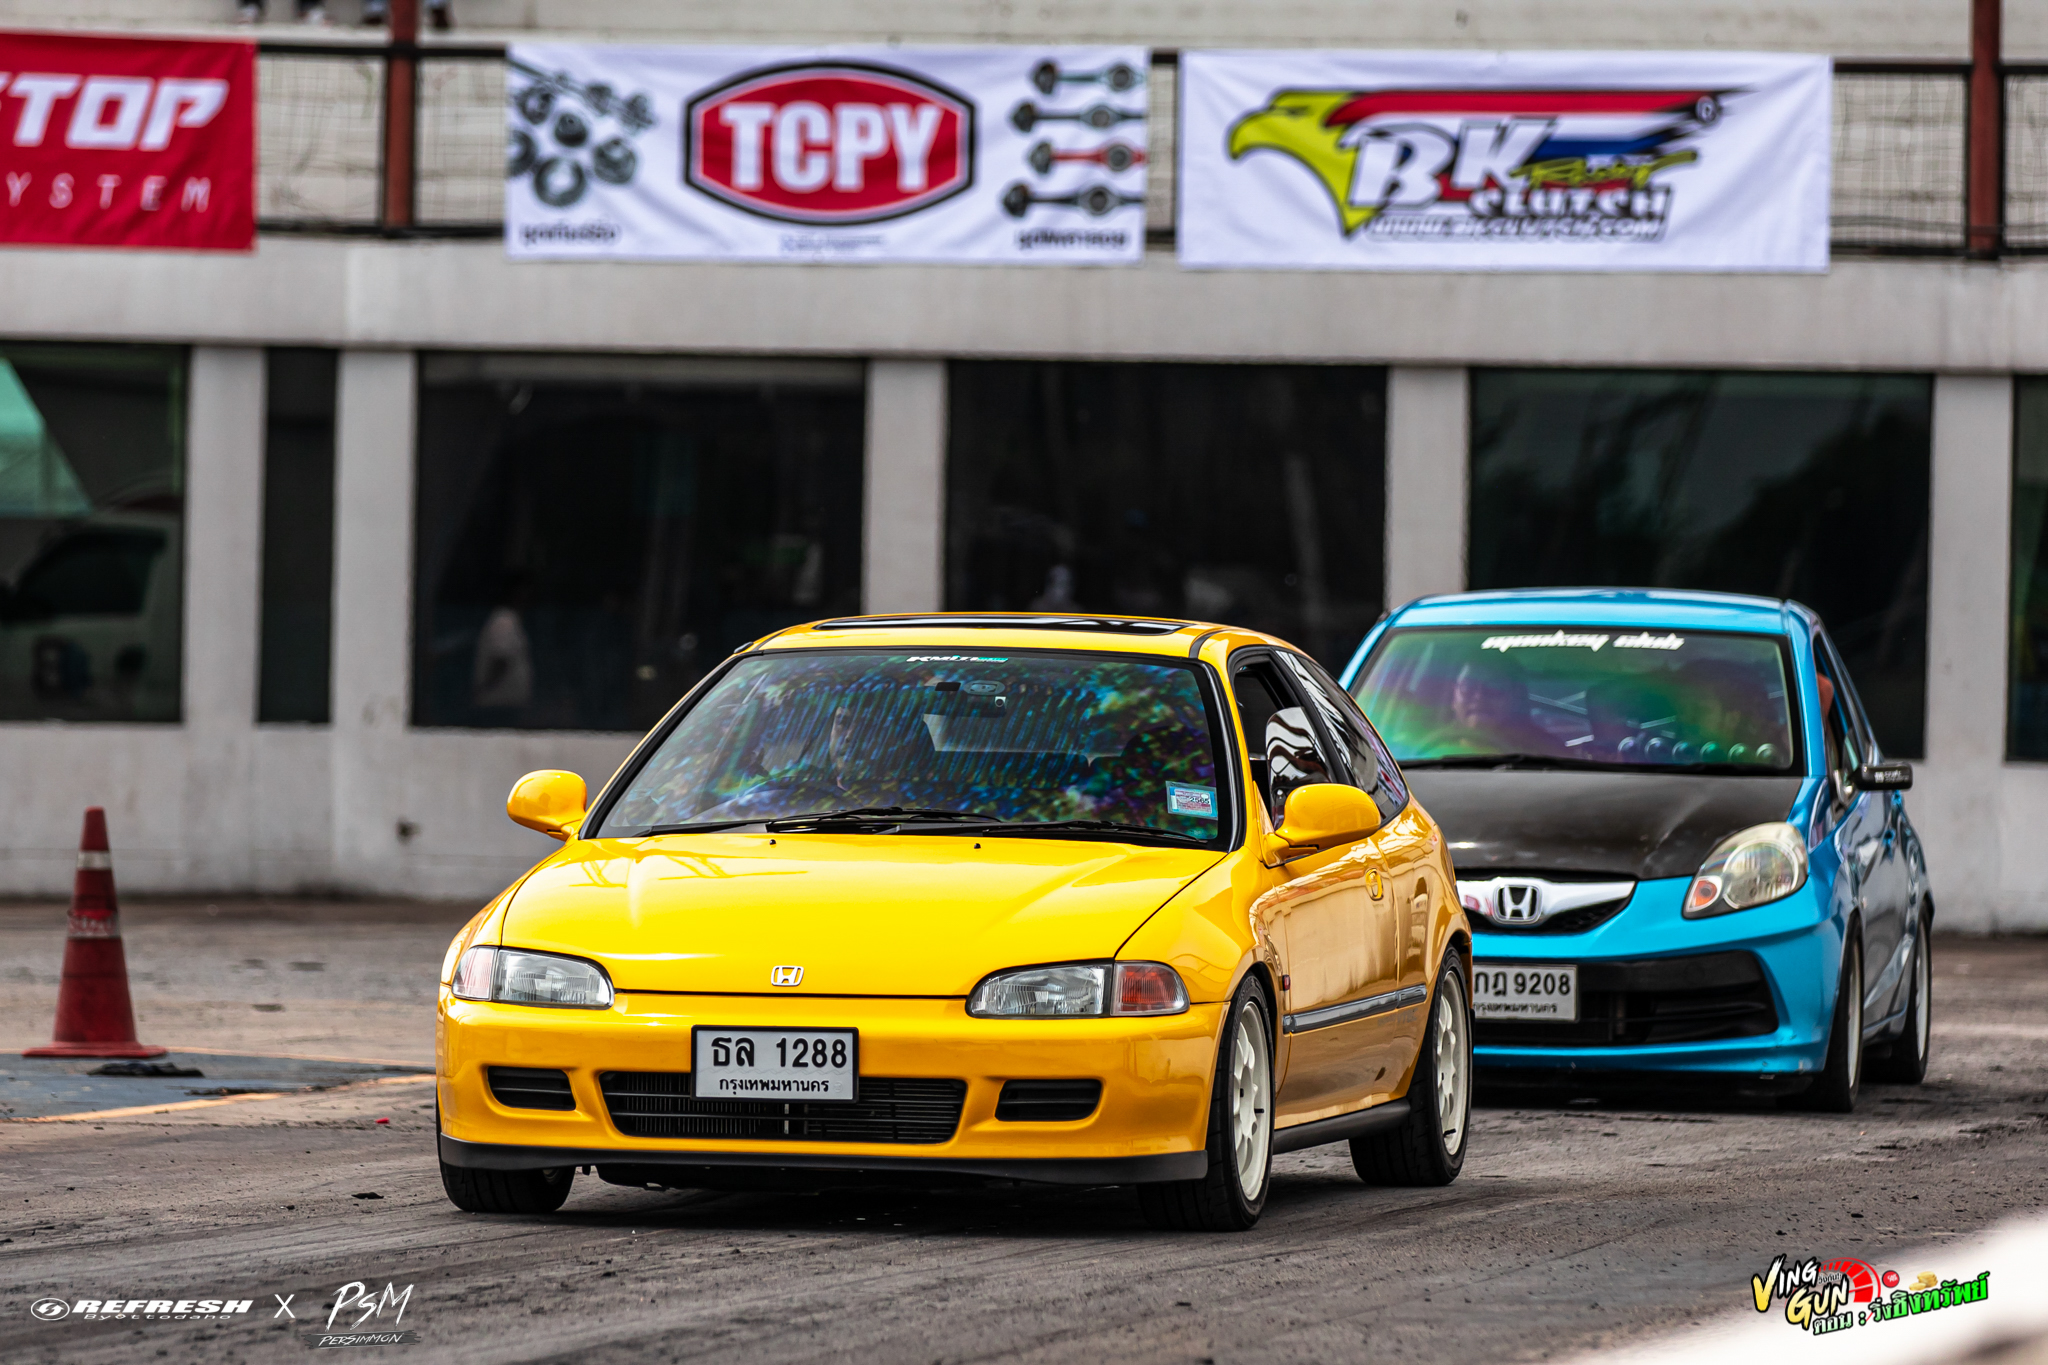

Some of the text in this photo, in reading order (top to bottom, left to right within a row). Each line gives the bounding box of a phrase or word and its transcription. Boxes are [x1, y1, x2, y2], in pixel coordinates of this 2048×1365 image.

[0, 70, 230, 151] TOP
[720, 102, 943, 192] TCPY
[1349, 115, 1557, 208] BK
[1514, 972, 1571, 996] 9208
[711, 1037, 847, 1068] ธล 1288
[719, 1078, 829, 1095] กรุงเทพมหานคร
